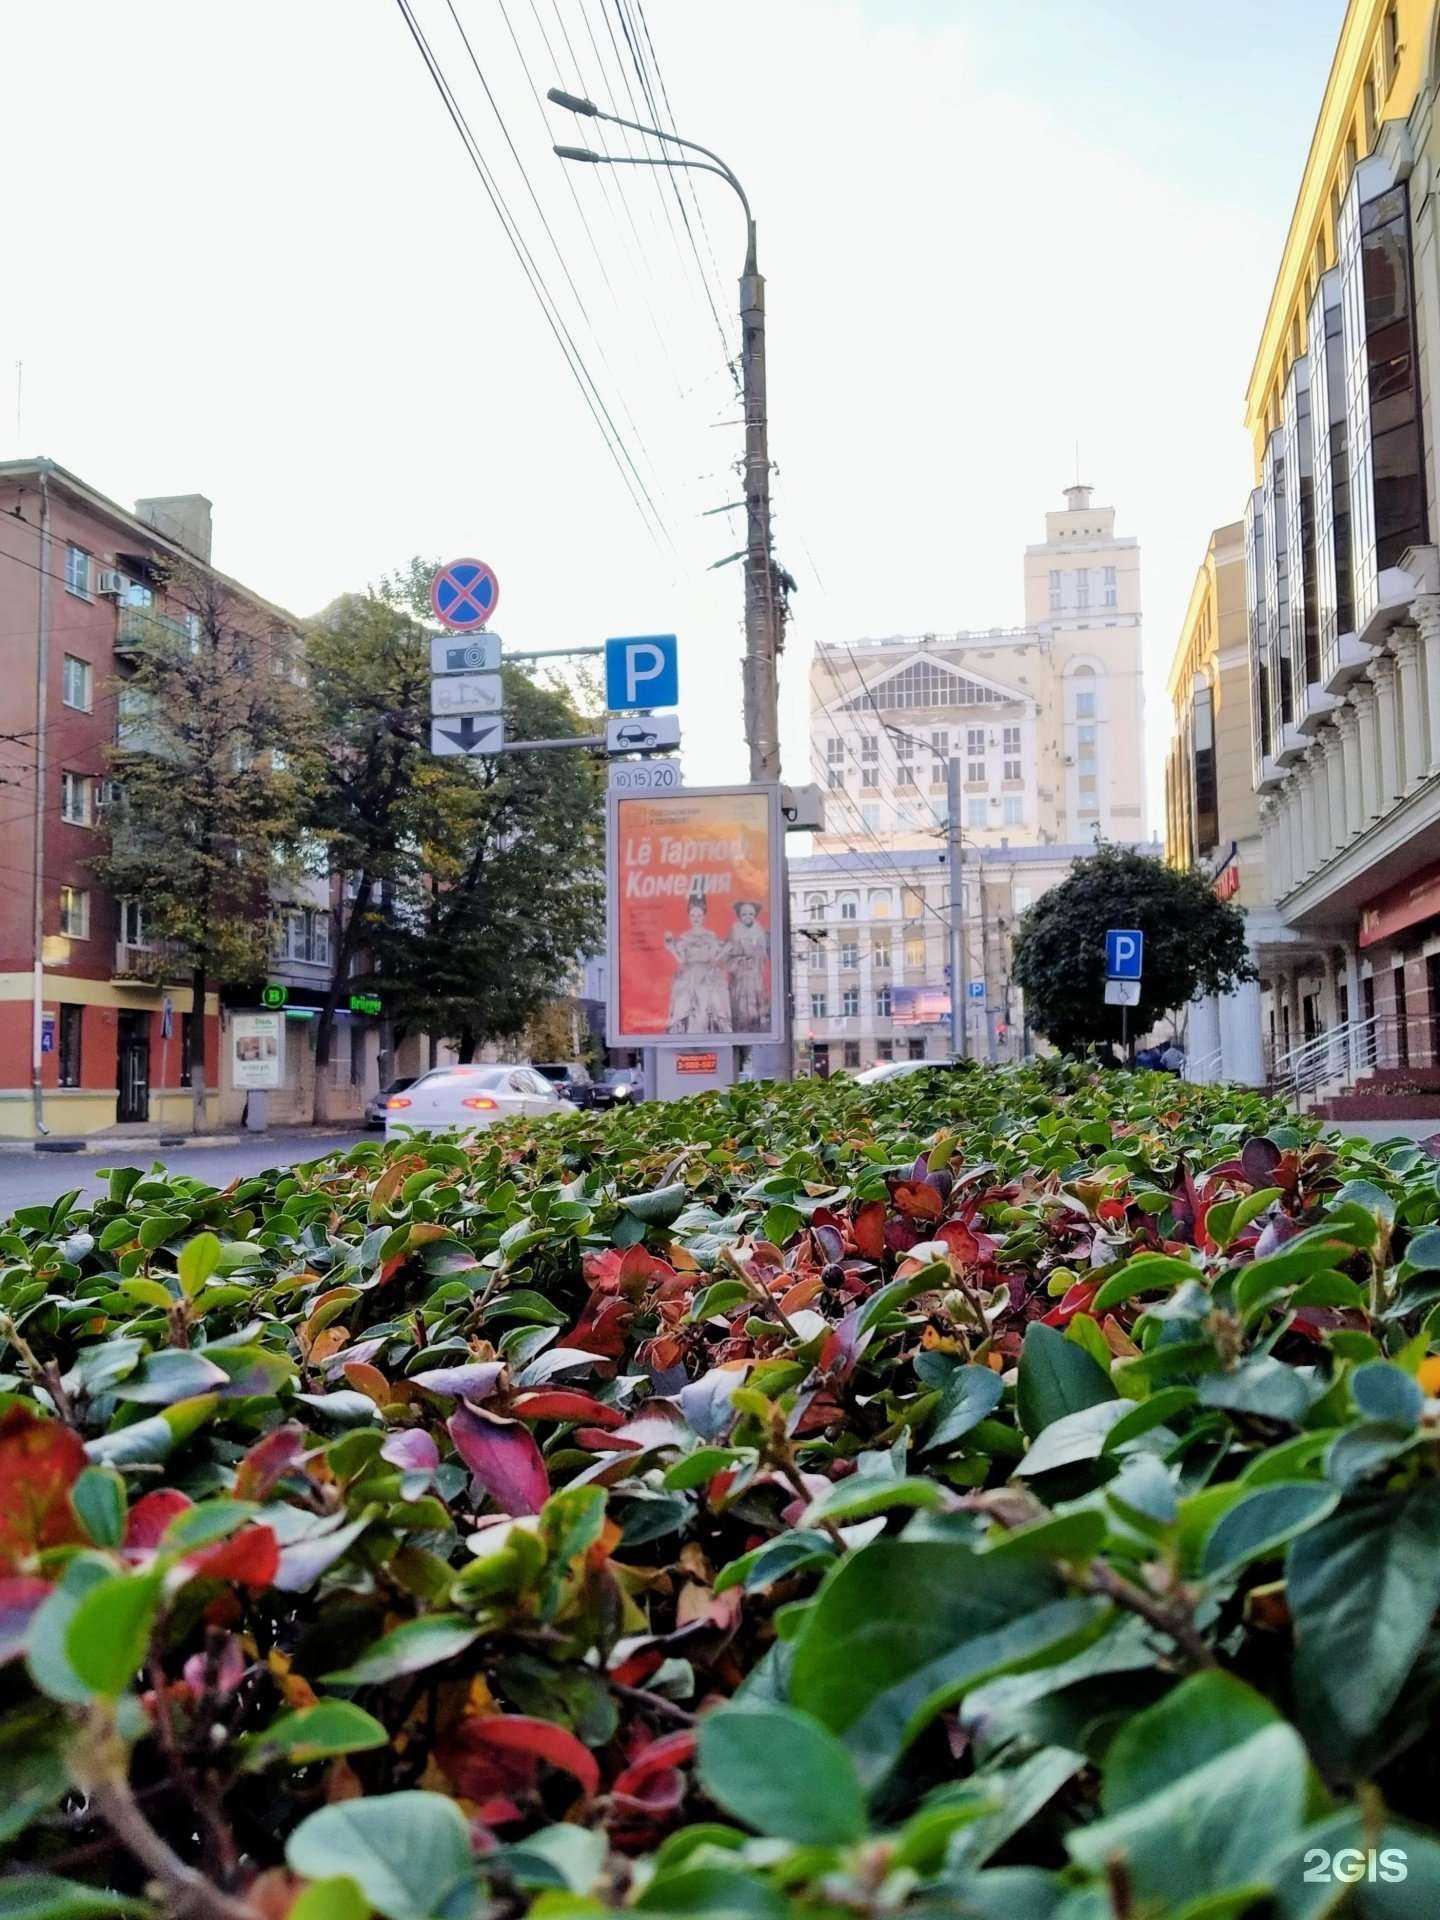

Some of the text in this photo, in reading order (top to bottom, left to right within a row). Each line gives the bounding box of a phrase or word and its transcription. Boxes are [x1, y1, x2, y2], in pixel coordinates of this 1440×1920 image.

[625, 643, 665, 702] P
[616, 769, 673, 786] 10 15 20
[625, 870, 732, 899] Комедия
[1116, 936, 1136, 972] P
[972, 983, 982, 997] P
